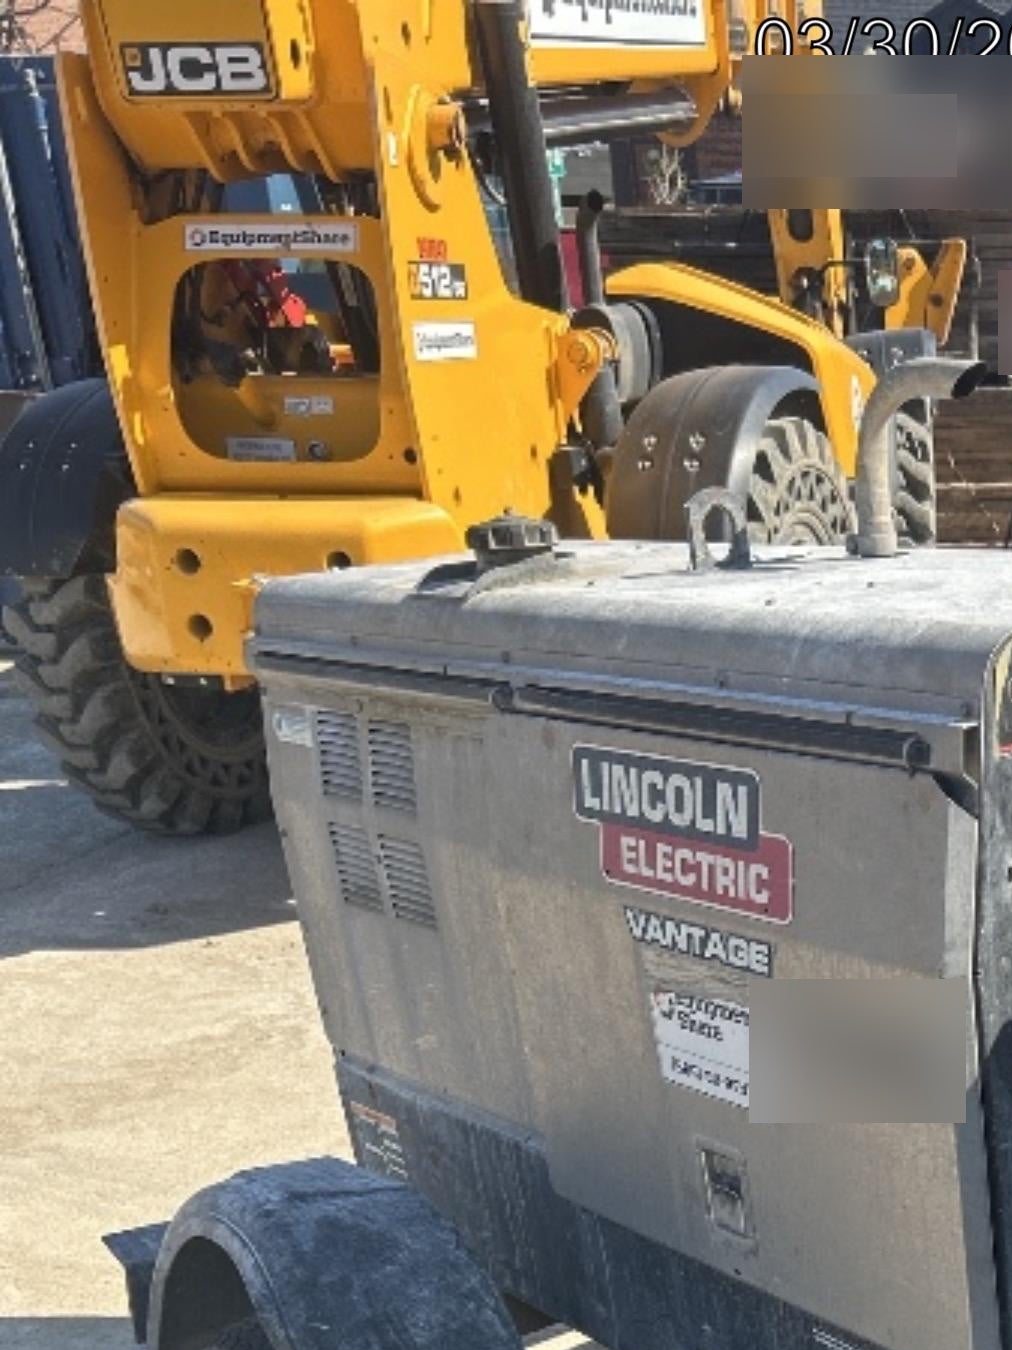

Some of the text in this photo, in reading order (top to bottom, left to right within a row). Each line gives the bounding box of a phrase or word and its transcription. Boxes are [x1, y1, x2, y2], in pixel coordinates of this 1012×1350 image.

[127, 47, 268, 91] JCB
[581, 758, 748, 840] LINCOLN
[620, 836, 769, 904] ELECTRIC
[626, 907, 769, 974] VANTAGE
